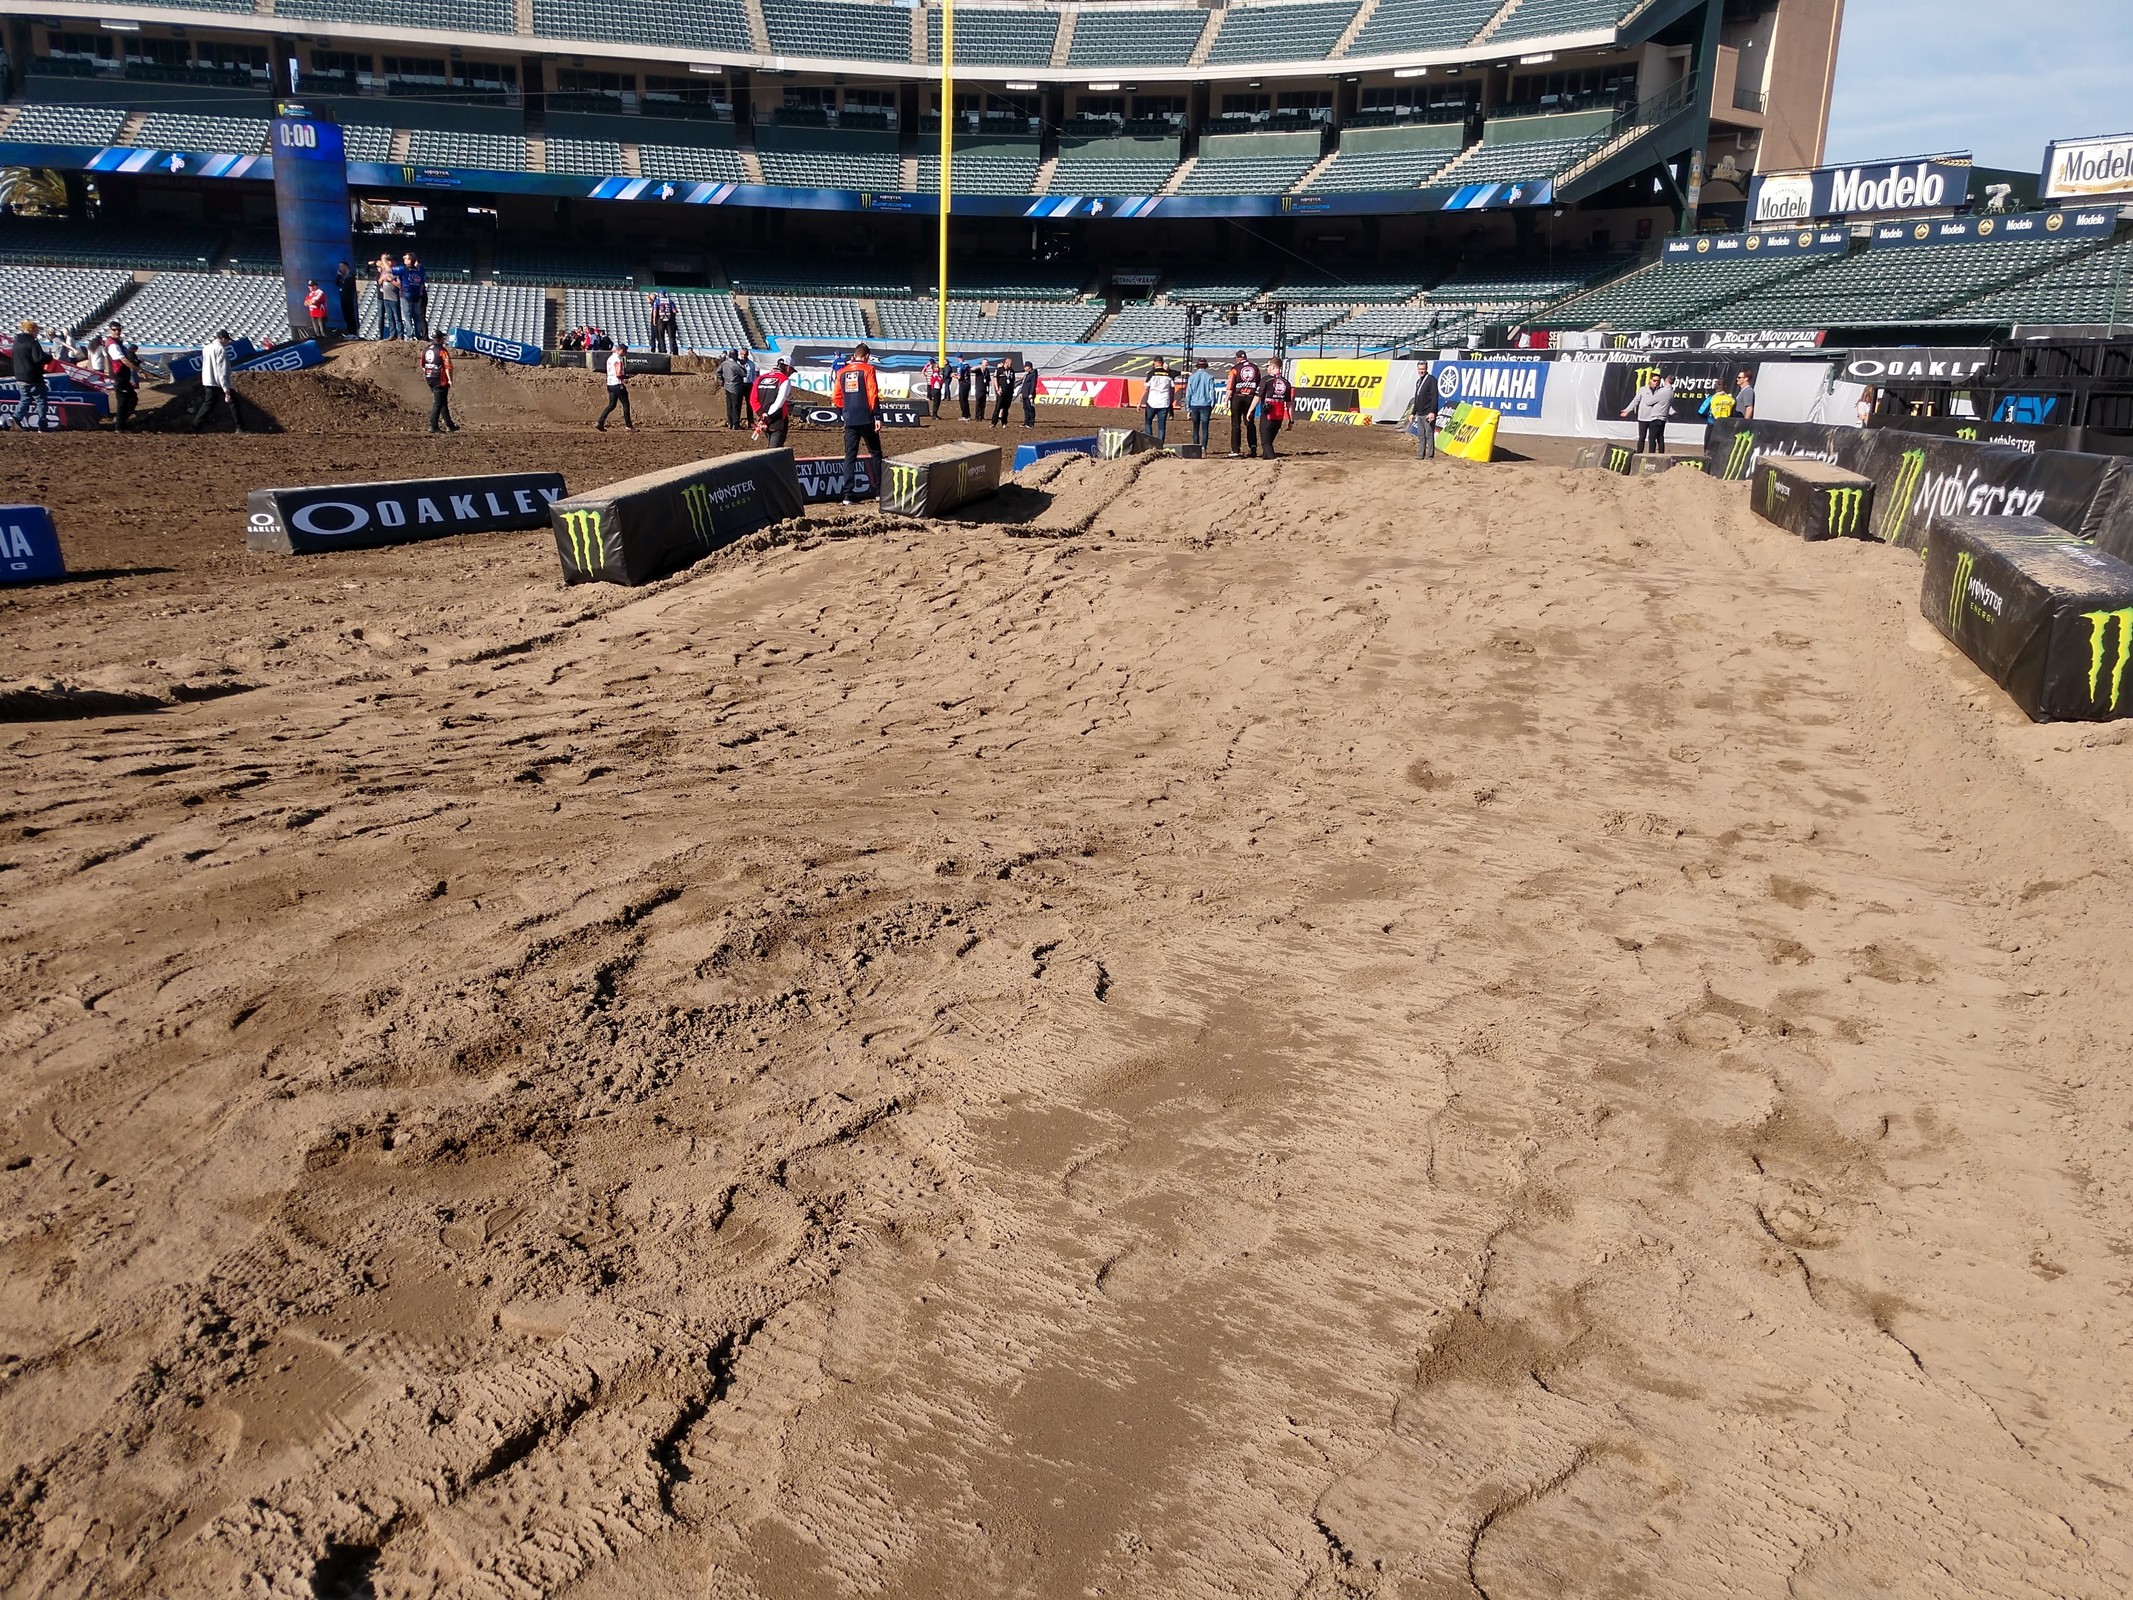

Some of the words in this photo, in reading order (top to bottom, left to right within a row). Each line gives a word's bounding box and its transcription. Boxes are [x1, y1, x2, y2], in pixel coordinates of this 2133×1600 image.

[280, 123, 317, 147] 0:00
[2064, 147, 2133, 181] Model
[1829, 162, 1944, 213] Modelo
[1759, 196, 1807, 219] Modelo
[2006, 219, 2033, 231] Modelo
[2076, 214, 2105, 226] Modelo
[1879, 228, 1903, 239] Modelo
[1940, 224, 1965, 235] Modelo
[1716, 239, 1738, 249] Modelo
[1767, 236, 1790, 247] Modelo
[1819, 233, 1842, 243] Modelo
[1669, 242, 1690, 252] Modelo
[1627, 335, 1689, 349] MNSTER
[1723, 332, 1757, 342] ROCKY
[1757, 331, 1817, 341] MOUNTAIN
[474, 335, 522, 361] WPS
[1574, 352, 1606, 362] ROCKY
[1608, 352, 1651, 363] MOUNTA
[1887, 361, 1986, 376] OAKLE
[1312, 375, 1382, 389] DUNLOP
[1461, 368, 1537, 399] YAMAHA
[1039, 396, 1084, 406] SUZUKI
[1294, 397, 1331, 412] TOYOTA
[1316, 413, 1358, 425] SUZUKI
[709, 480, 756, 504] MONSTER
[376, 487, 561, 528] OAKLEY
[719, 496, 752, 512] ENERGY
[247, 525, 282, 533] OAKLEY
[1967, 576, 2003, 617] MONSTER
[1970, 602, 1996, 625] ENERGY
